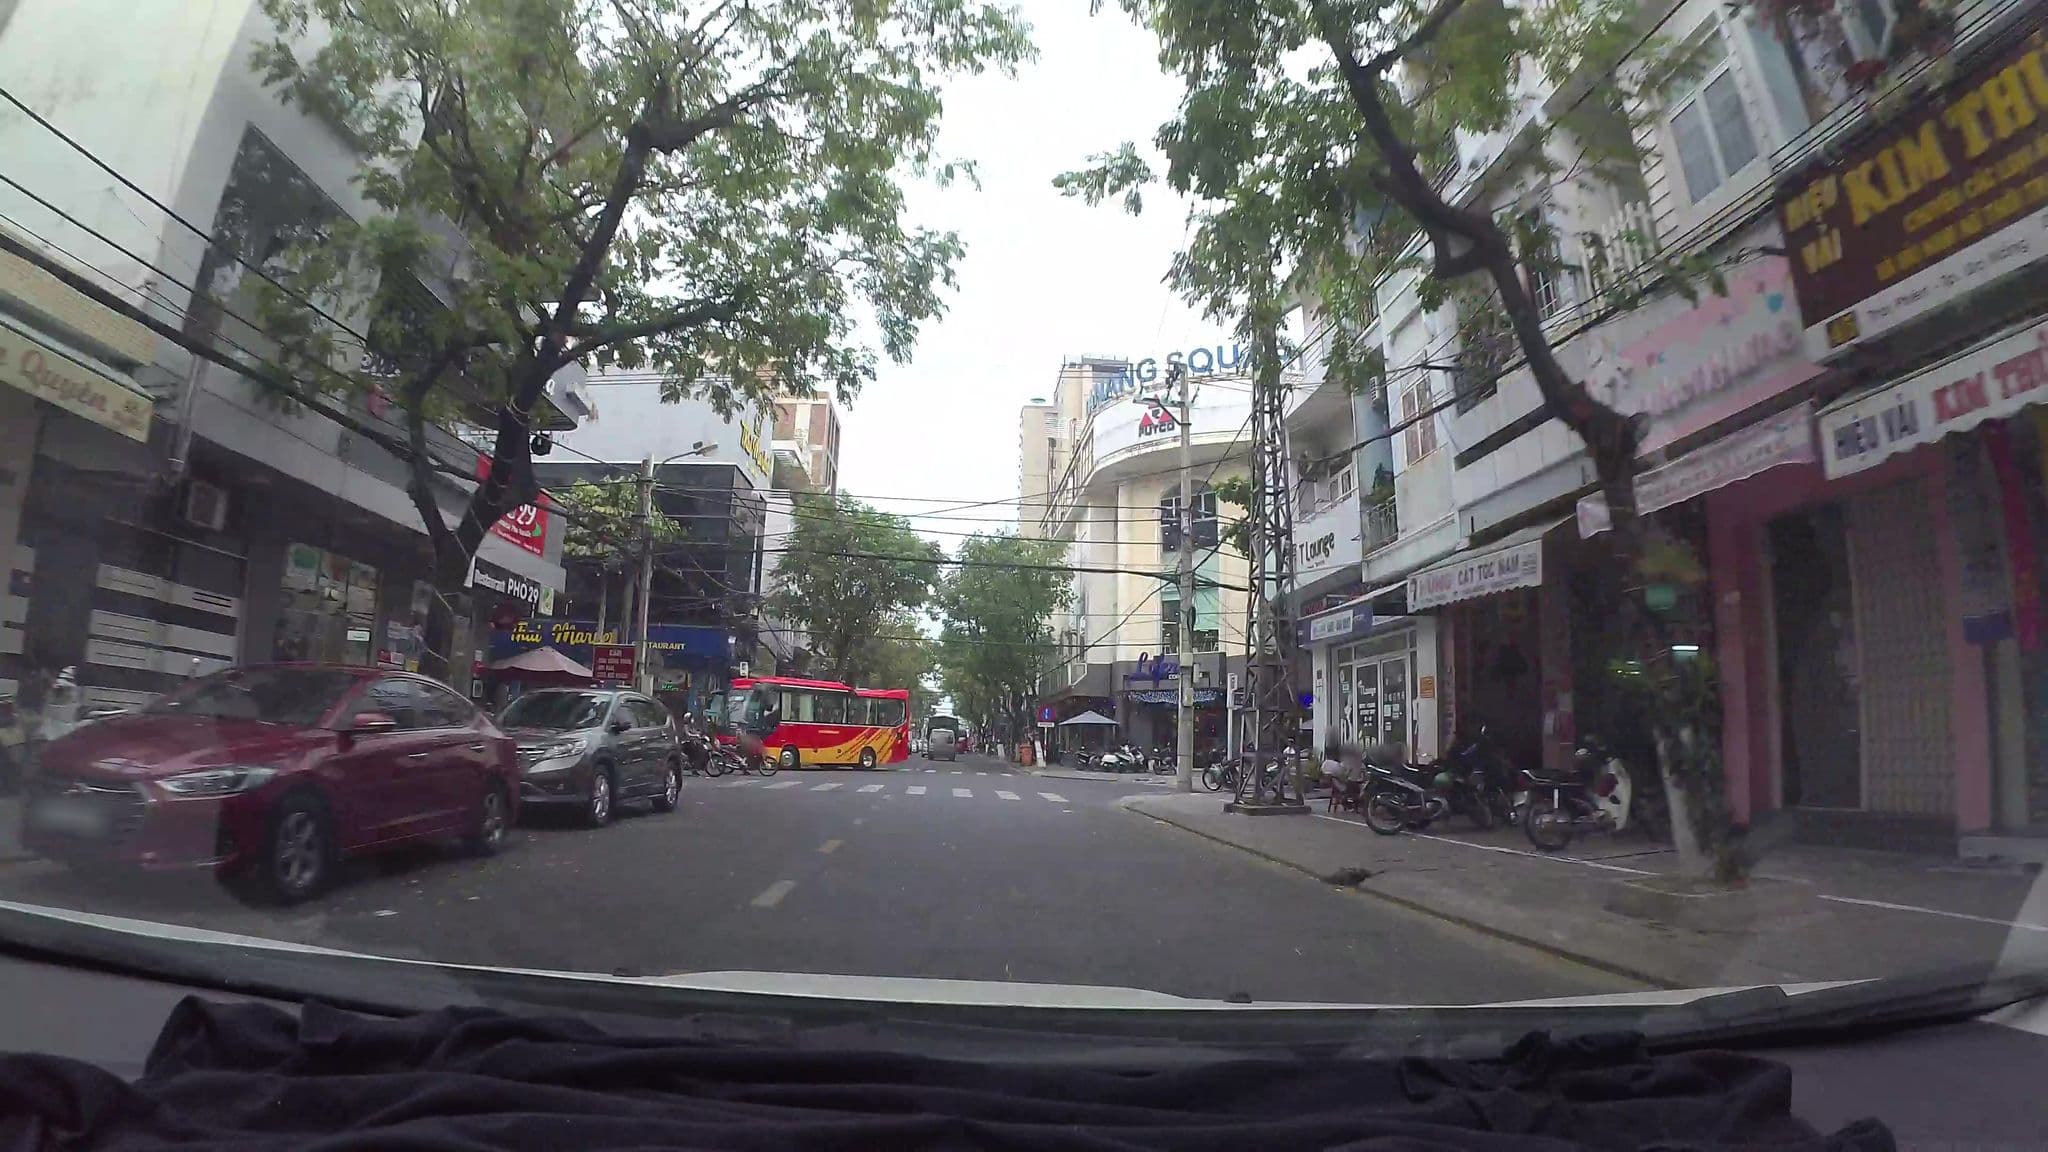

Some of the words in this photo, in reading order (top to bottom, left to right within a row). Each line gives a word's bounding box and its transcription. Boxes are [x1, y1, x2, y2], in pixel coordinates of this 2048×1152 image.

[1842, 119, 1951, 226] KIM
[1932, 371, 1991, 424] KIM
[1305, 531, 1335, 561] Lounge
[527, 586, 539, 604] 29
